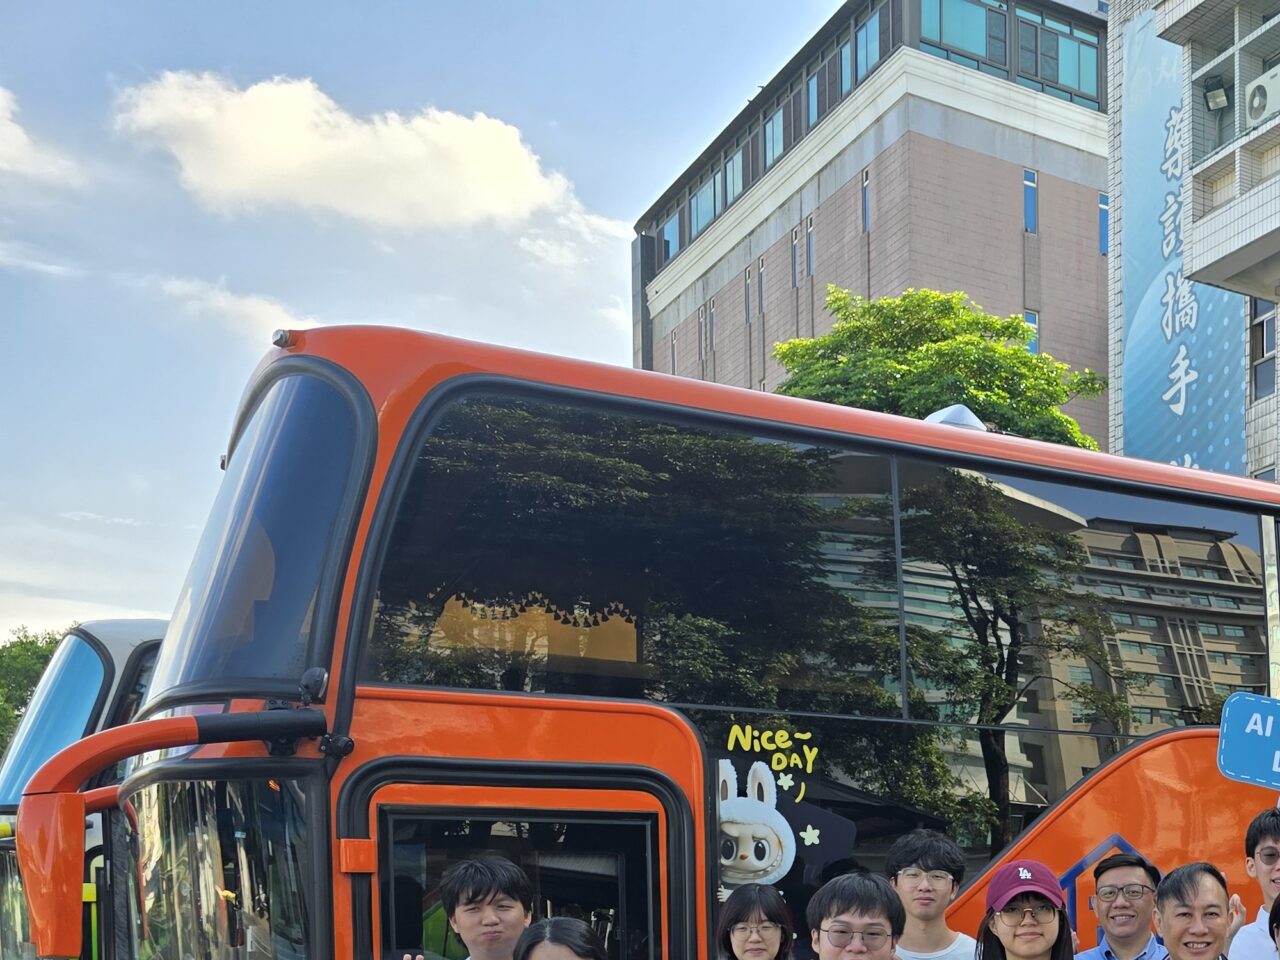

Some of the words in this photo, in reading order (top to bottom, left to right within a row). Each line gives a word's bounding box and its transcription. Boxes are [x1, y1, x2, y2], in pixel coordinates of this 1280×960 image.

[1245, 712, 1274, 737] AI
[771, 744, 818, 774] DAY
[1018, 867, 1031, 879] LA
